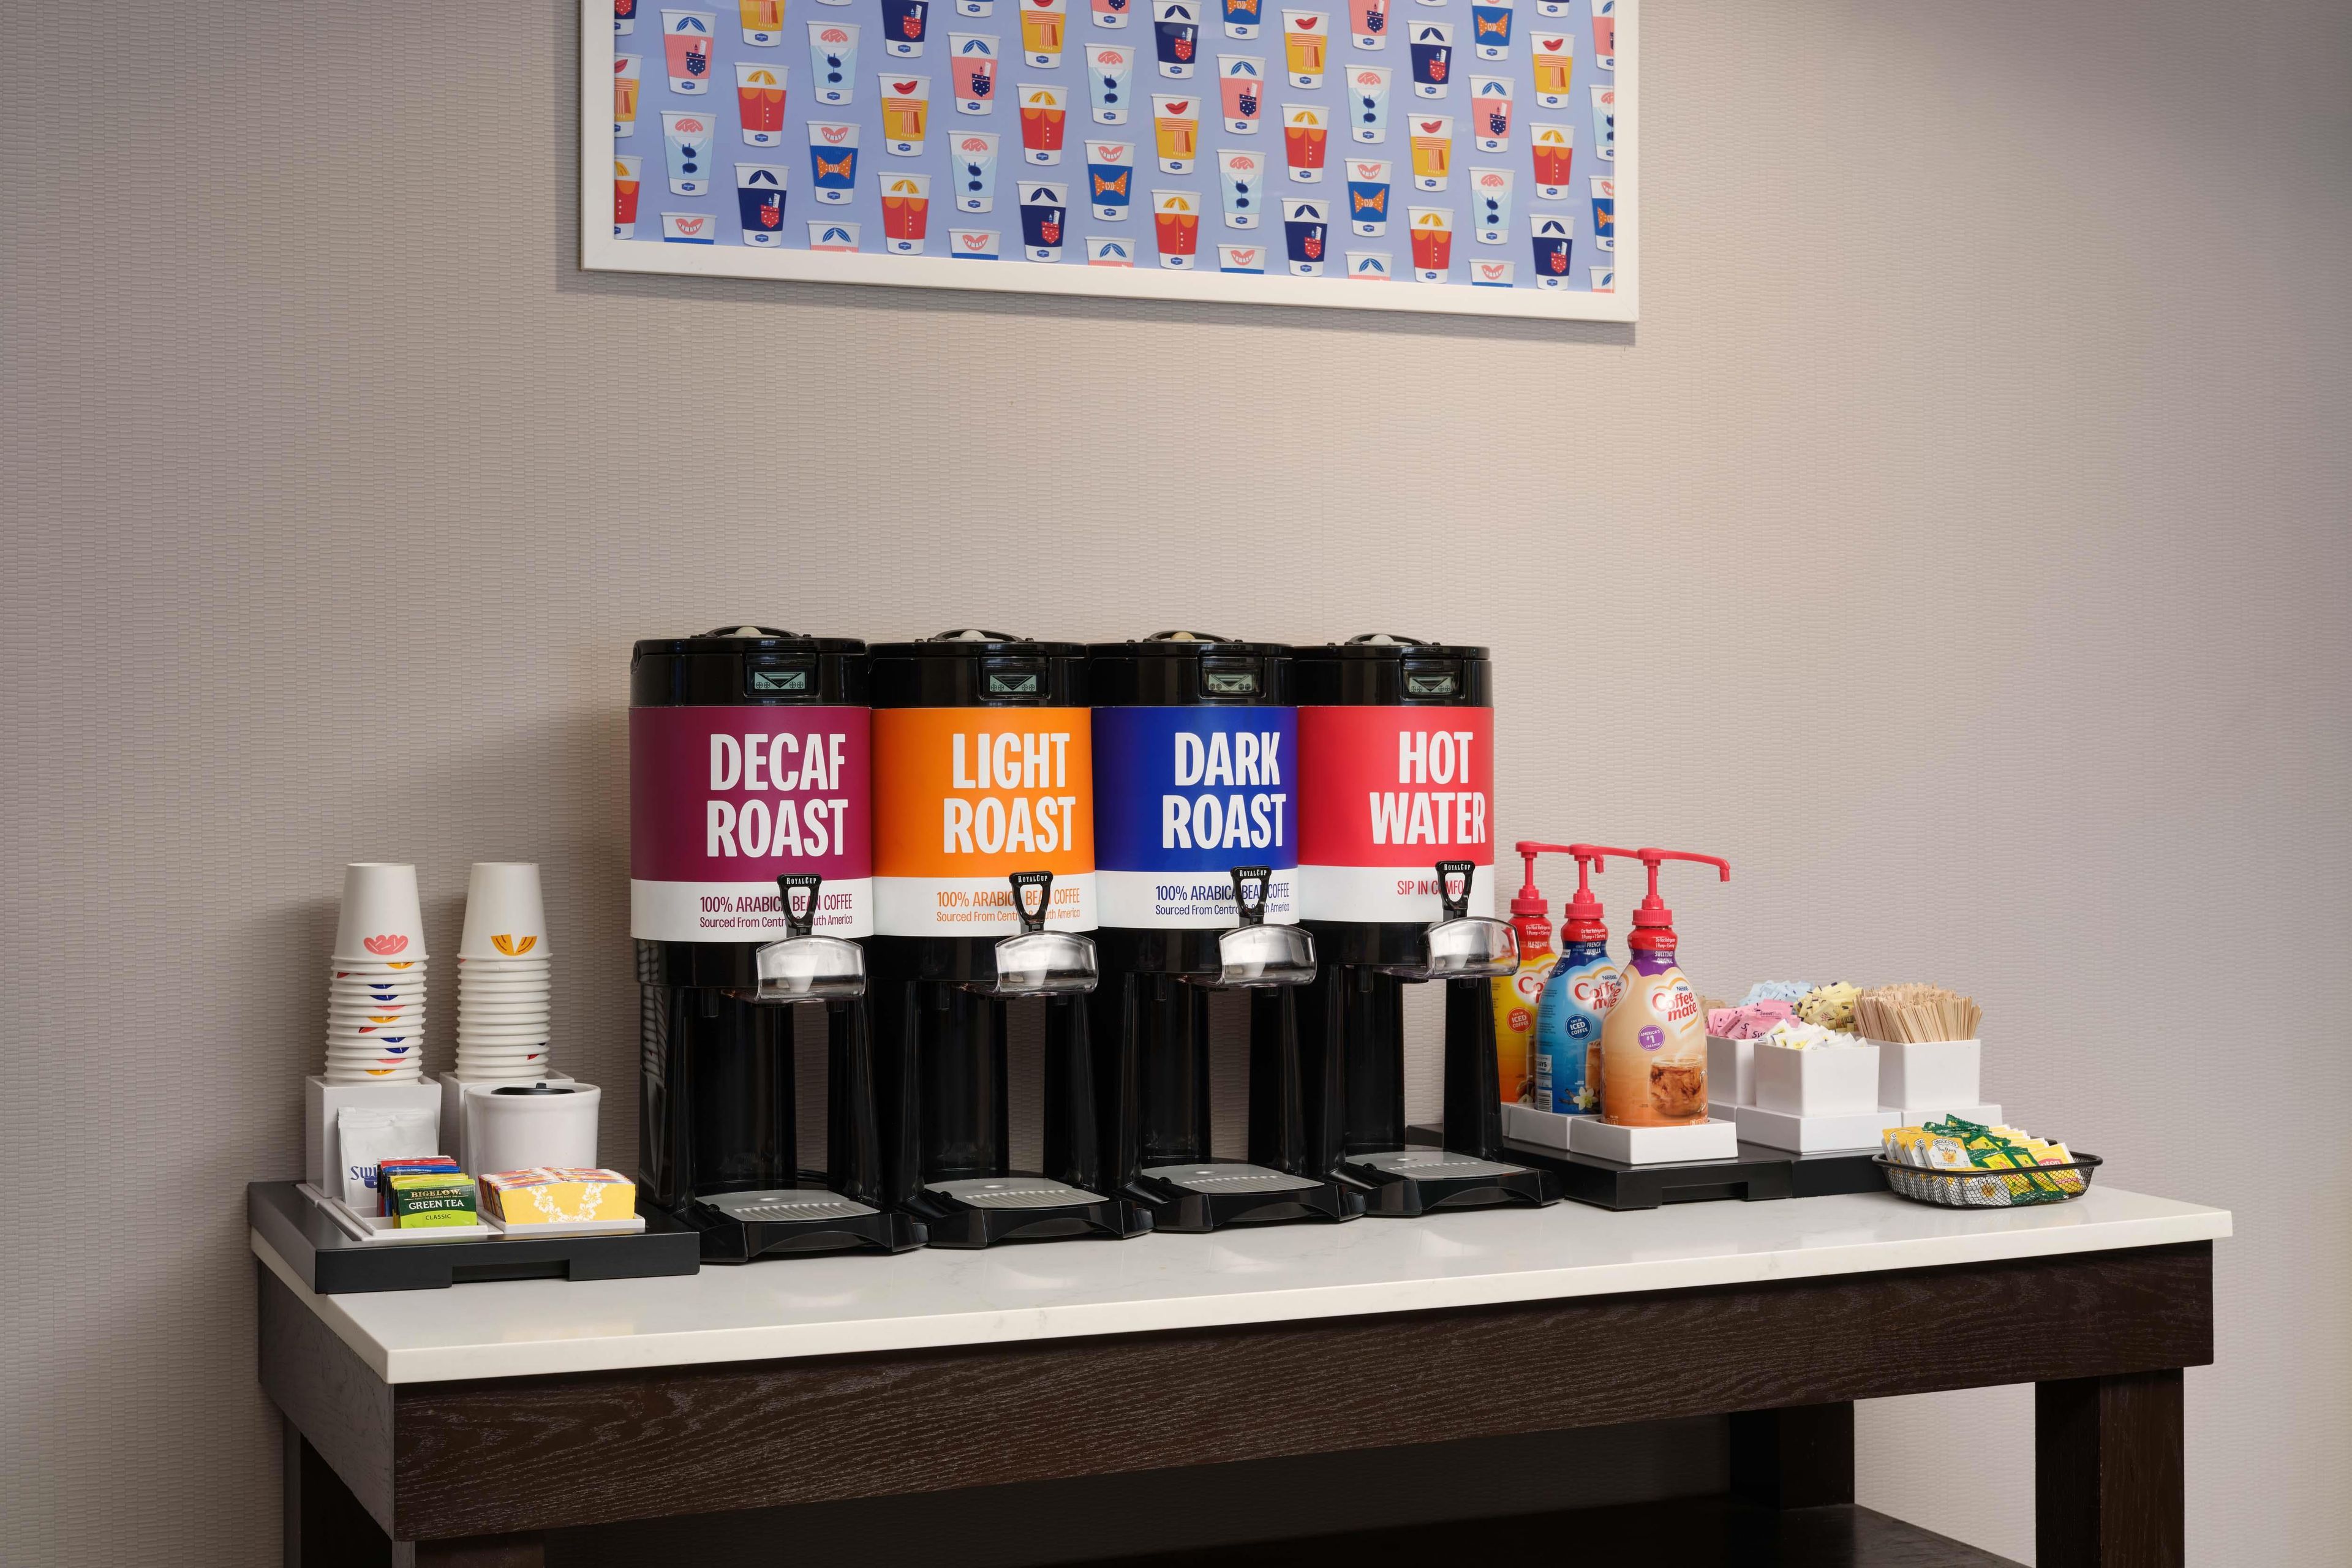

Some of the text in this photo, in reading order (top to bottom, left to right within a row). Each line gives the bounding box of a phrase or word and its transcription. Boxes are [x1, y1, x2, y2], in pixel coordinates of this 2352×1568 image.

[710, 733, 846, 791] DECAF
[952, 732, 1071, 790] LIGHT
[1175, 731, 1281, 786] DARK
[1398, 731, 1473, 785] HOT
[706, 798, 849, 858] ROAST
[943, 796, 1076, 854] ROAST
[1162, 793, 1287, 850] ROAST
[1370, 792, 1486, 845] WATER
[937, 891, 970, 907] 100%
[973, 891, 1014, 907] ARABIC
[1054, 888, 1080, 905] COFFEE
[1156, 885, 1188, 901] 100%
[1242, 884, 1263, 900] BEA
[1268, 883, 1289, 899] COFFEE
[1396, 880, 1471, 895] SIP IN CMFO
[700, 896, 733, 913] 100%
[736, 895, 783, 913] ARABIC
[824, 893, 853, 911] COFFEE
[1155, 904, 1190, 915] Sourced
[1191, 905, 1213, 915] From
[1214, 904, 1239, 915] Centr
[1270, 902, 1290, 913] America
[699, 916, 735, 928] Sourced
[737, 917, 760, 928] From
[761, 916, 786, 927] Centr
[827, 913, 853, 925] America
[937, 911, 972, 922] Sourced
[973, 911, 995, 922] From
[997, 911, 1020, 922] Centr
[1057, 908, 1080, 919] America
[1652, 992, 1694, 1012] Coffee
[1667, 1002, 1697, 1022] mate
[1512, 1015, 1527, 1023] ICED
[1570, 1022, 1586, 1031] ICED
[1646, 1035, 1655, 1044] #1
[409, 1199, 465, 1210] GREEN TEA
